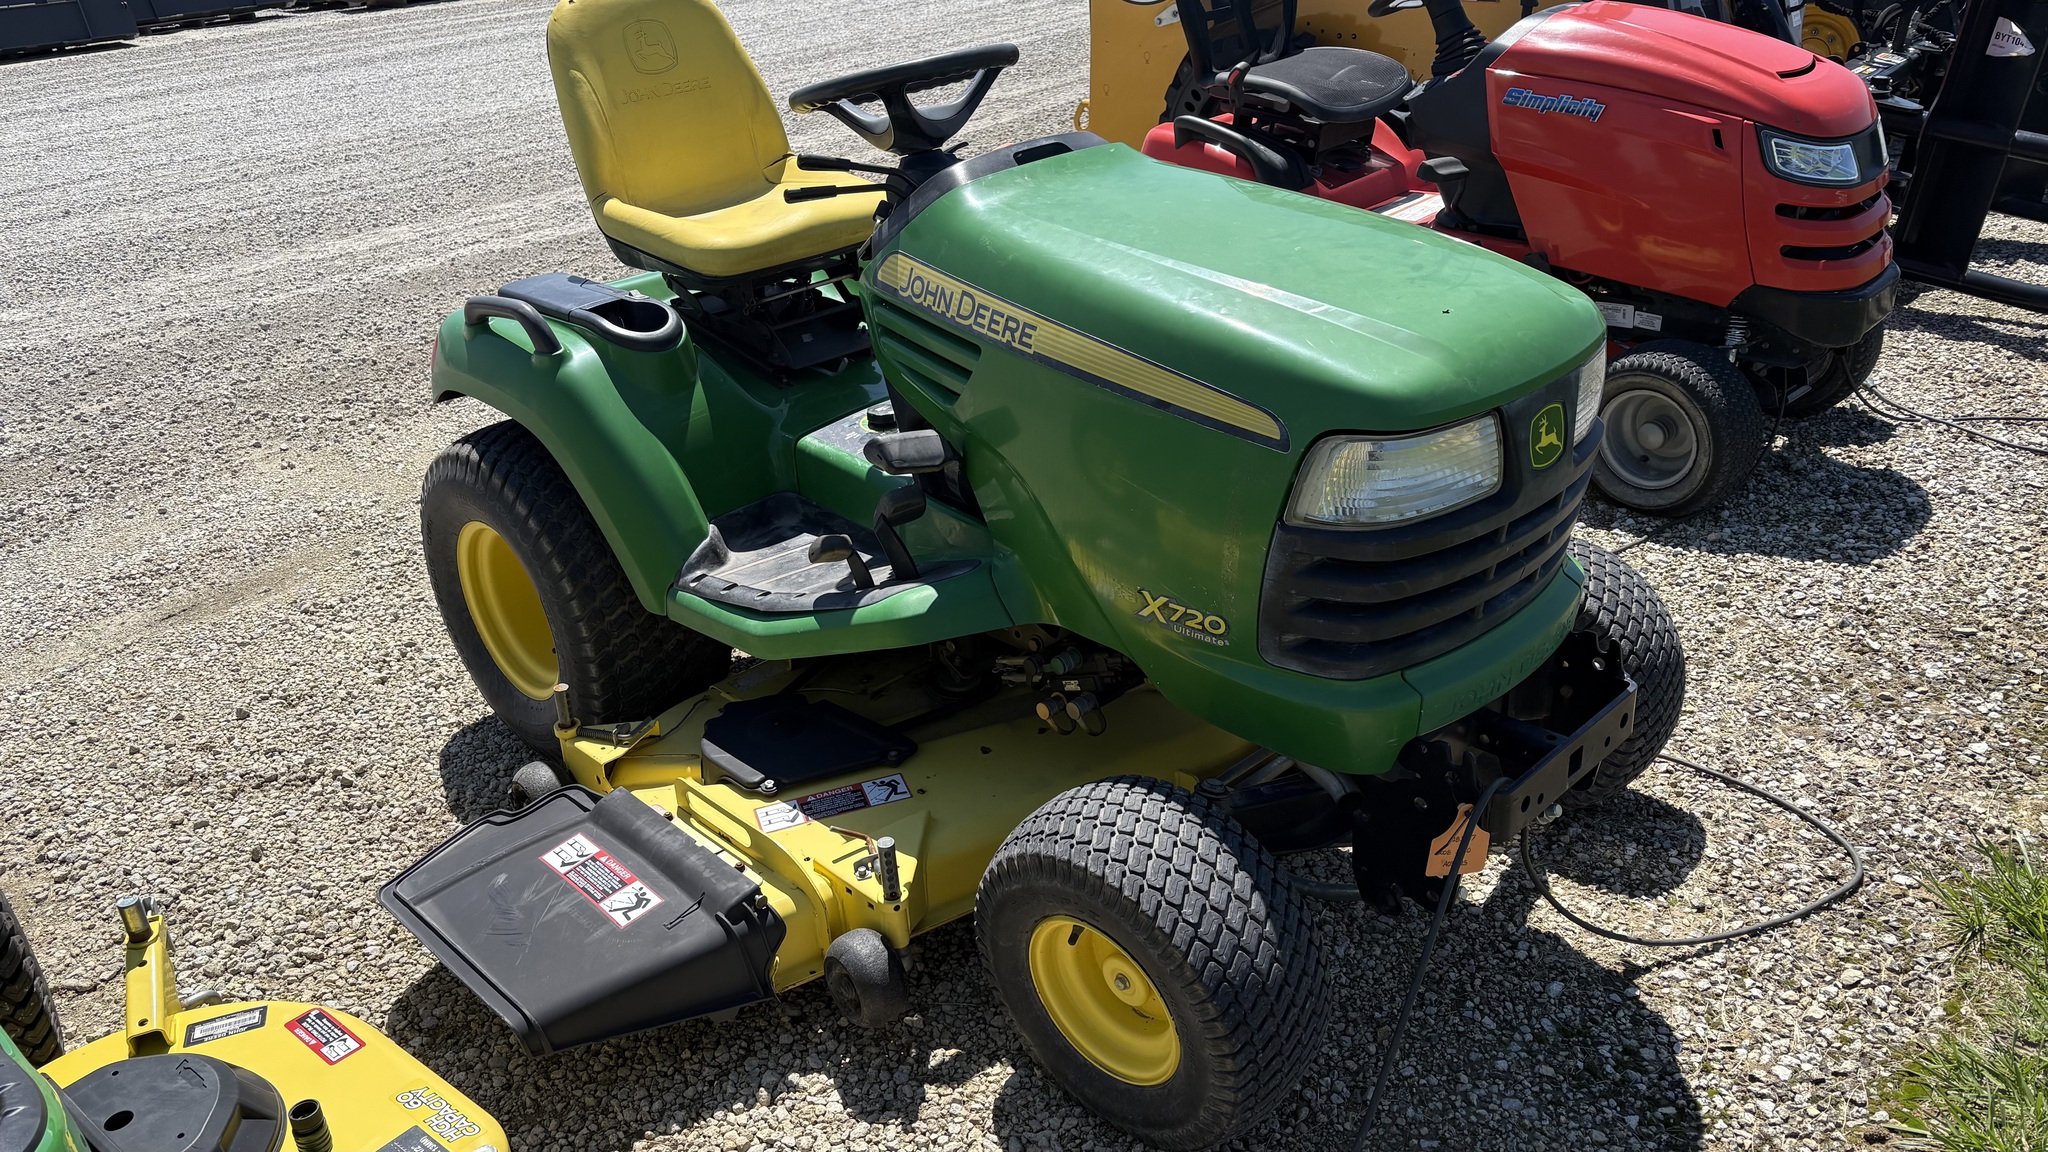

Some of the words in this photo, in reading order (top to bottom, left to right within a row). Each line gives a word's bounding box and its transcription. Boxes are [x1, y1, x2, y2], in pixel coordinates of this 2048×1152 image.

[621, 86, 660, 105] JOHN
[661, 76, 712, 97] DEERE
[1502, 87, 1606, 123] Simplicity
[899, 267, 955, 315] JOHN
[955, 290, 1039, 351] DEERE
[1136, 589, 1228, 636] X720
[1173, 624, 1225, 647] Ultimate
[816, 786, 853, 799] DANGER
[605, 858, 632, 880] DANGER
[293, 1027, 313, 1043] DANGER
[396, 1092, 423, 1110] 60
[409, 1086, 481, 1136] CAPACITY
[423, 1114, 464, 1143] HIGH
